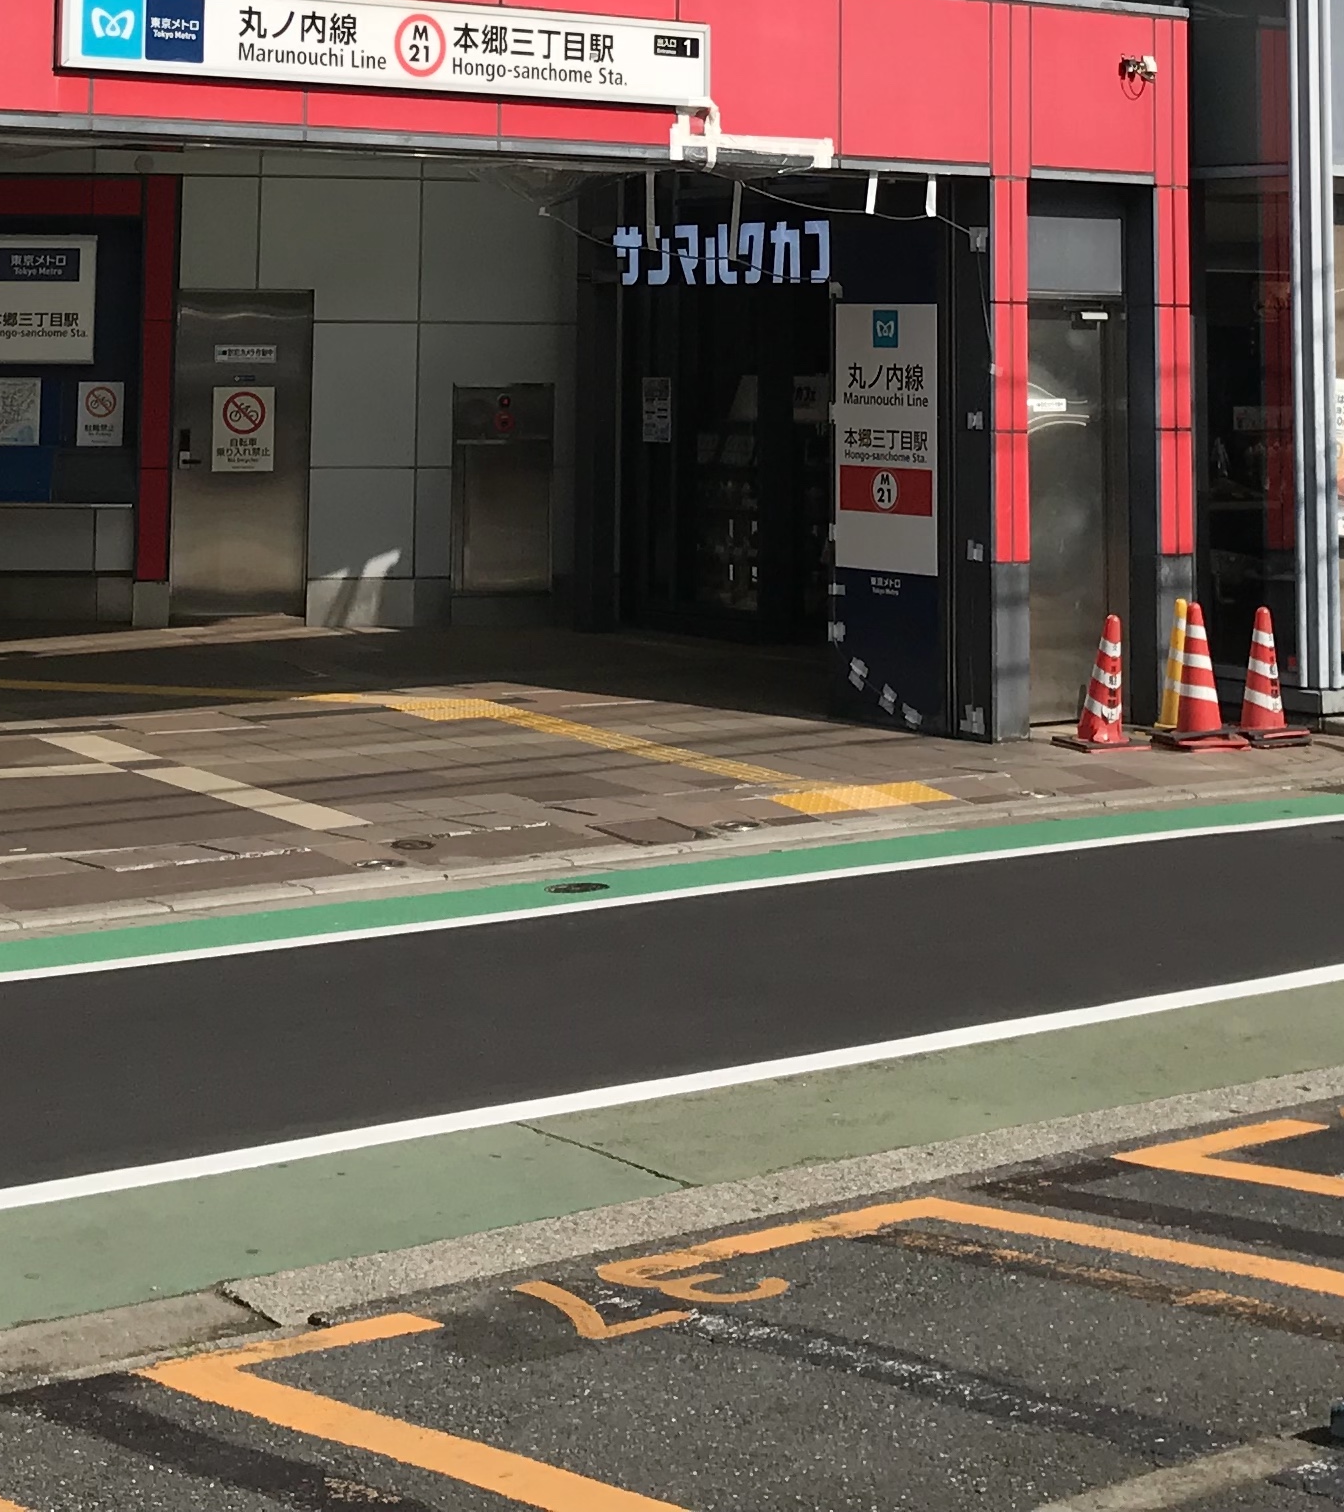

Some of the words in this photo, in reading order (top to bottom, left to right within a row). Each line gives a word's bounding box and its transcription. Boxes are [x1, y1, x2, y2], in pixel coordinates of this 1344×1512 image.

[150, 17, 200, 31] 東京メトロ
[239, 6, 357, 45] 丸ノ内線
[153, 29, 174, 40] Tokyo
[174, 32, 197, 41] Metro
[413, 25, 429, 41] M
[453, 23, 614, 63] 本郷三丁目駅
[657, 38, 677, 48] 出入口
[684, 39, 691, 56] 1
[238, 42, 344, 68] Marunouchi
[351, 49, 387, 70] Line
[409, 45, 430, 63] 21
[452, 57, 593, 84] Hongo-sanchome
[599, 67, 628, 86] Sta.
[10, 254, 67, 266] 東京メトロ
[14, 267, 37, 276] Tokyo
[39, 267, 63, 276] Metro
[70, 328, 88, 338] Sta.
[848, 362, 924, 391] 丸ノ内線
[843, 392, 904, 407] Marunouchi
[907, 394, 929, 408] Line
[229, 438, 257, 447] 自転車
[844, 428, 928, 451] 本郷三丁目駅
[216, 447, 271, 457] 乗り入れ禁止
[844, 449, 910, 463] Hongo-sanchome
[912, 452, 927, 463] Sta.
[880, 474, 890, 485] M
[877, 487, 892, 503] 21
[870, 577, 901, 589] 東京メトロ
[513, 1252, 790, 1340] 37
